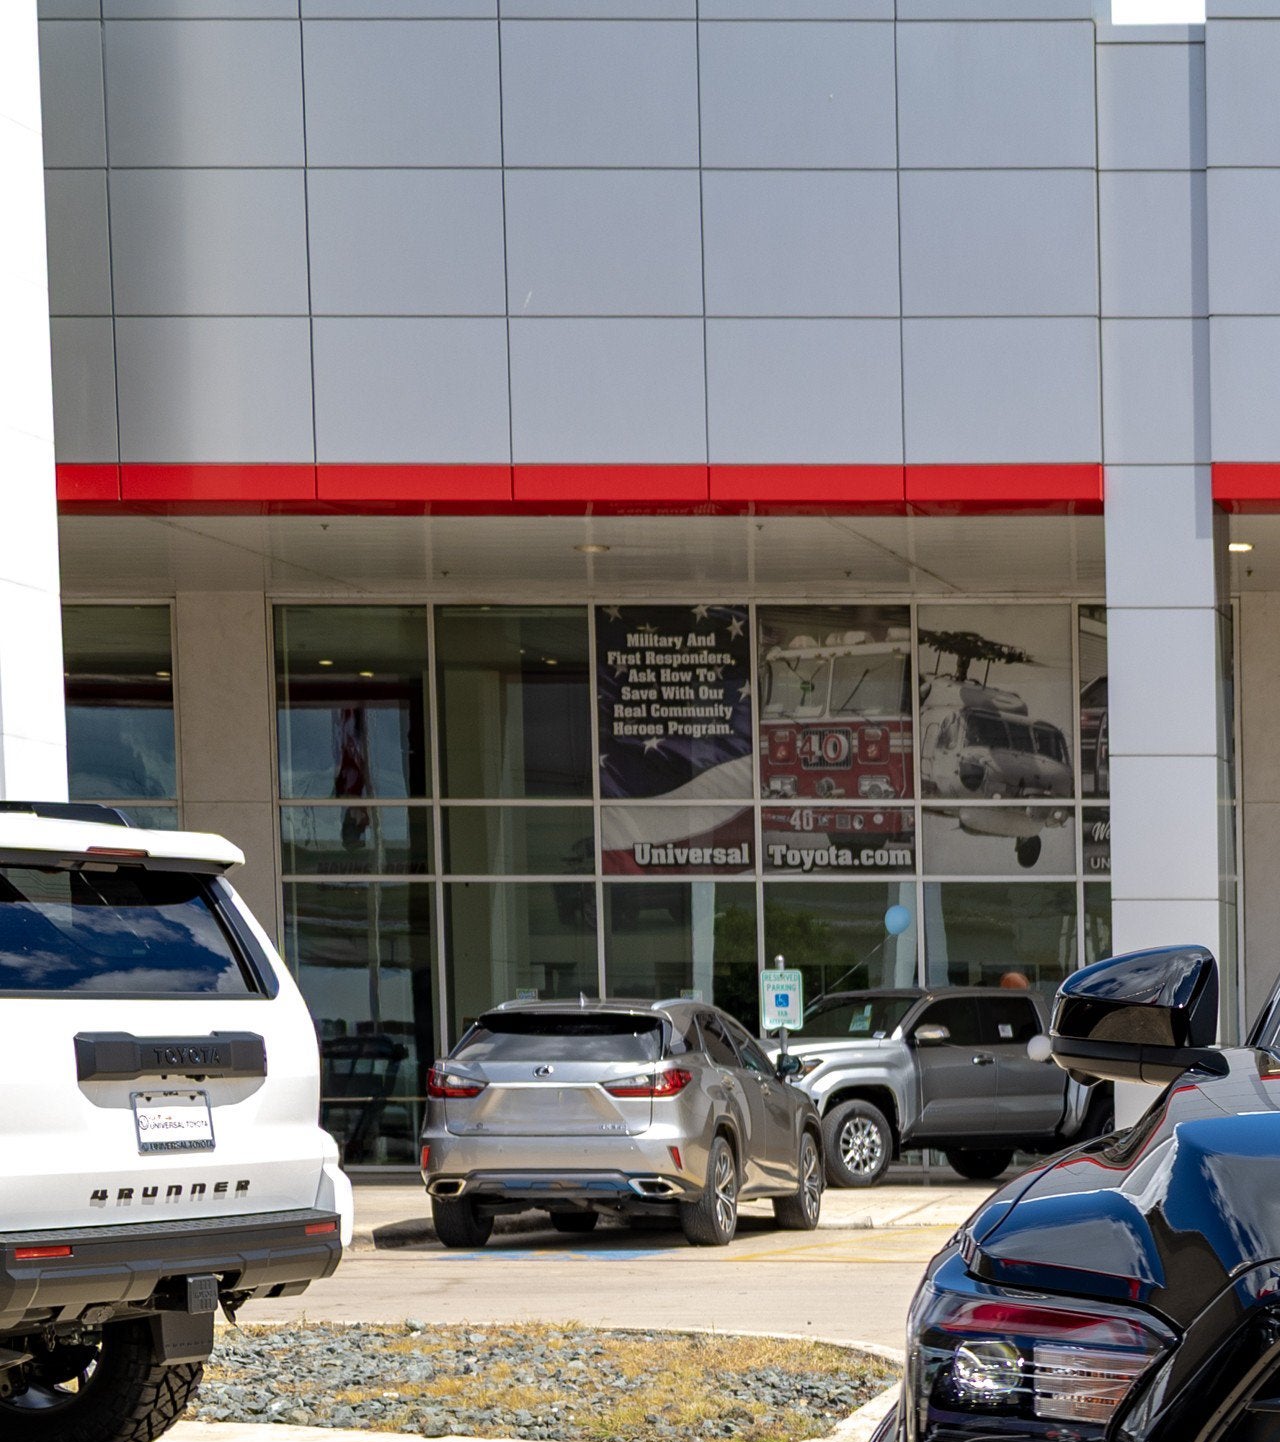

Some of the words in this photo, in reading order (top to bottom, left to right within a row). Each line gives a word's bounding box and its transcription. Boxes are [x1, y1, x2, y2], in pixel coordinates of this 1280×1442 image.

[626, 632, 682, 650] Military
[686, 632, 716, 647] And
[607, 651, 641, 665] First
[645, 650, 736, 668] Responders,
[628, 668, 656, 682] Ask
[660, 668, 692, 682] How
[696, 668, 716, 682] To
[621, 686, 657, 700] Save
[661, 686, 694, 700] With
[698, 686, 724, 699] Our
[613, 703, 647, 718] Real
[650, 703, 733, 720] Community
[613, 721, 664, 736] Heroes
[667, 721, 734, 738] Program.
[799, 734, 849, 764] 40
[790, 809, 814, 831] 40
[633, 842, 750, 866] Universal
[768, 844, 912, 872] Toyota.com
[153, 1046, 221, 1065] TOYOTA
[90, 1179, 250, 1201] 4RUNNER
